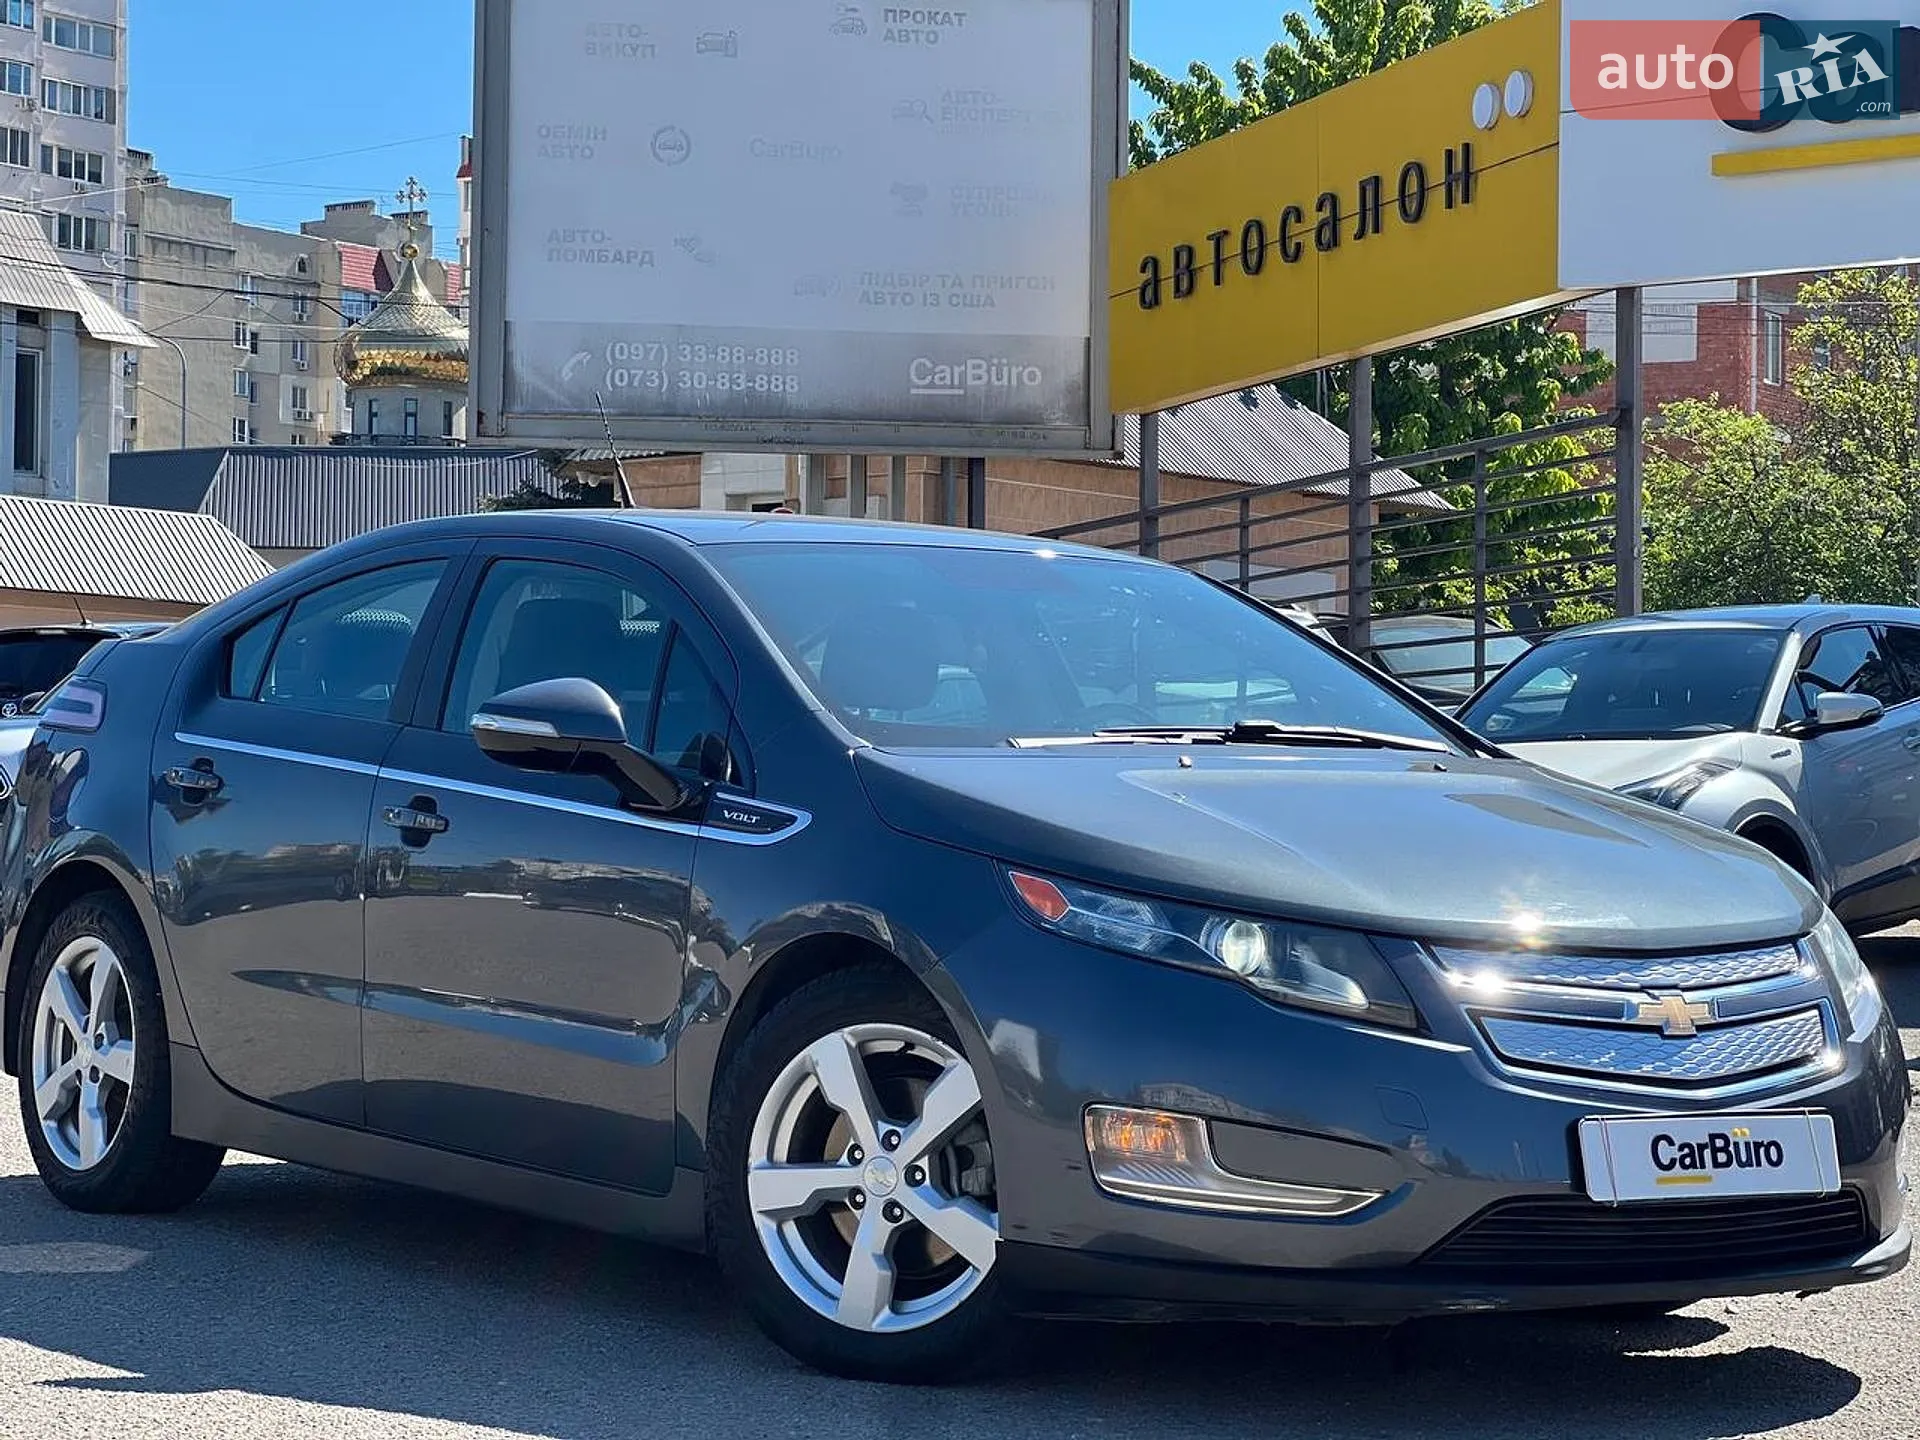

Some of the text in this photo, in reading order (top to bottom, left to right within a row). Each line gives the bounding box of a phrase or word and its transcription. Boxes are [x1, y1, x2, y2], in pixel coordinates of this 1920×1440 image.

[883, 8, 967, 27] ПРОКАТ
[883, 29, 939, 45] АВТО
[547, 228, 612, 243] АВТО-
[1139, 142, 1474, 310] автосалон
[859, 272, 1056, 290] ПІДБІР ТА ПРИГОН
[859, 291, 996, 308] АВТО ІЗ США
[606, 342, 799, 366] (097) 33-88-888
[606, 368, 799, 392] (073) 30-83-888
[910, 357, 1042, 386] CarBüro
[723, 809, 760, 824] VOLT
[1651, 1128, 1784, 1171] CarBüro
